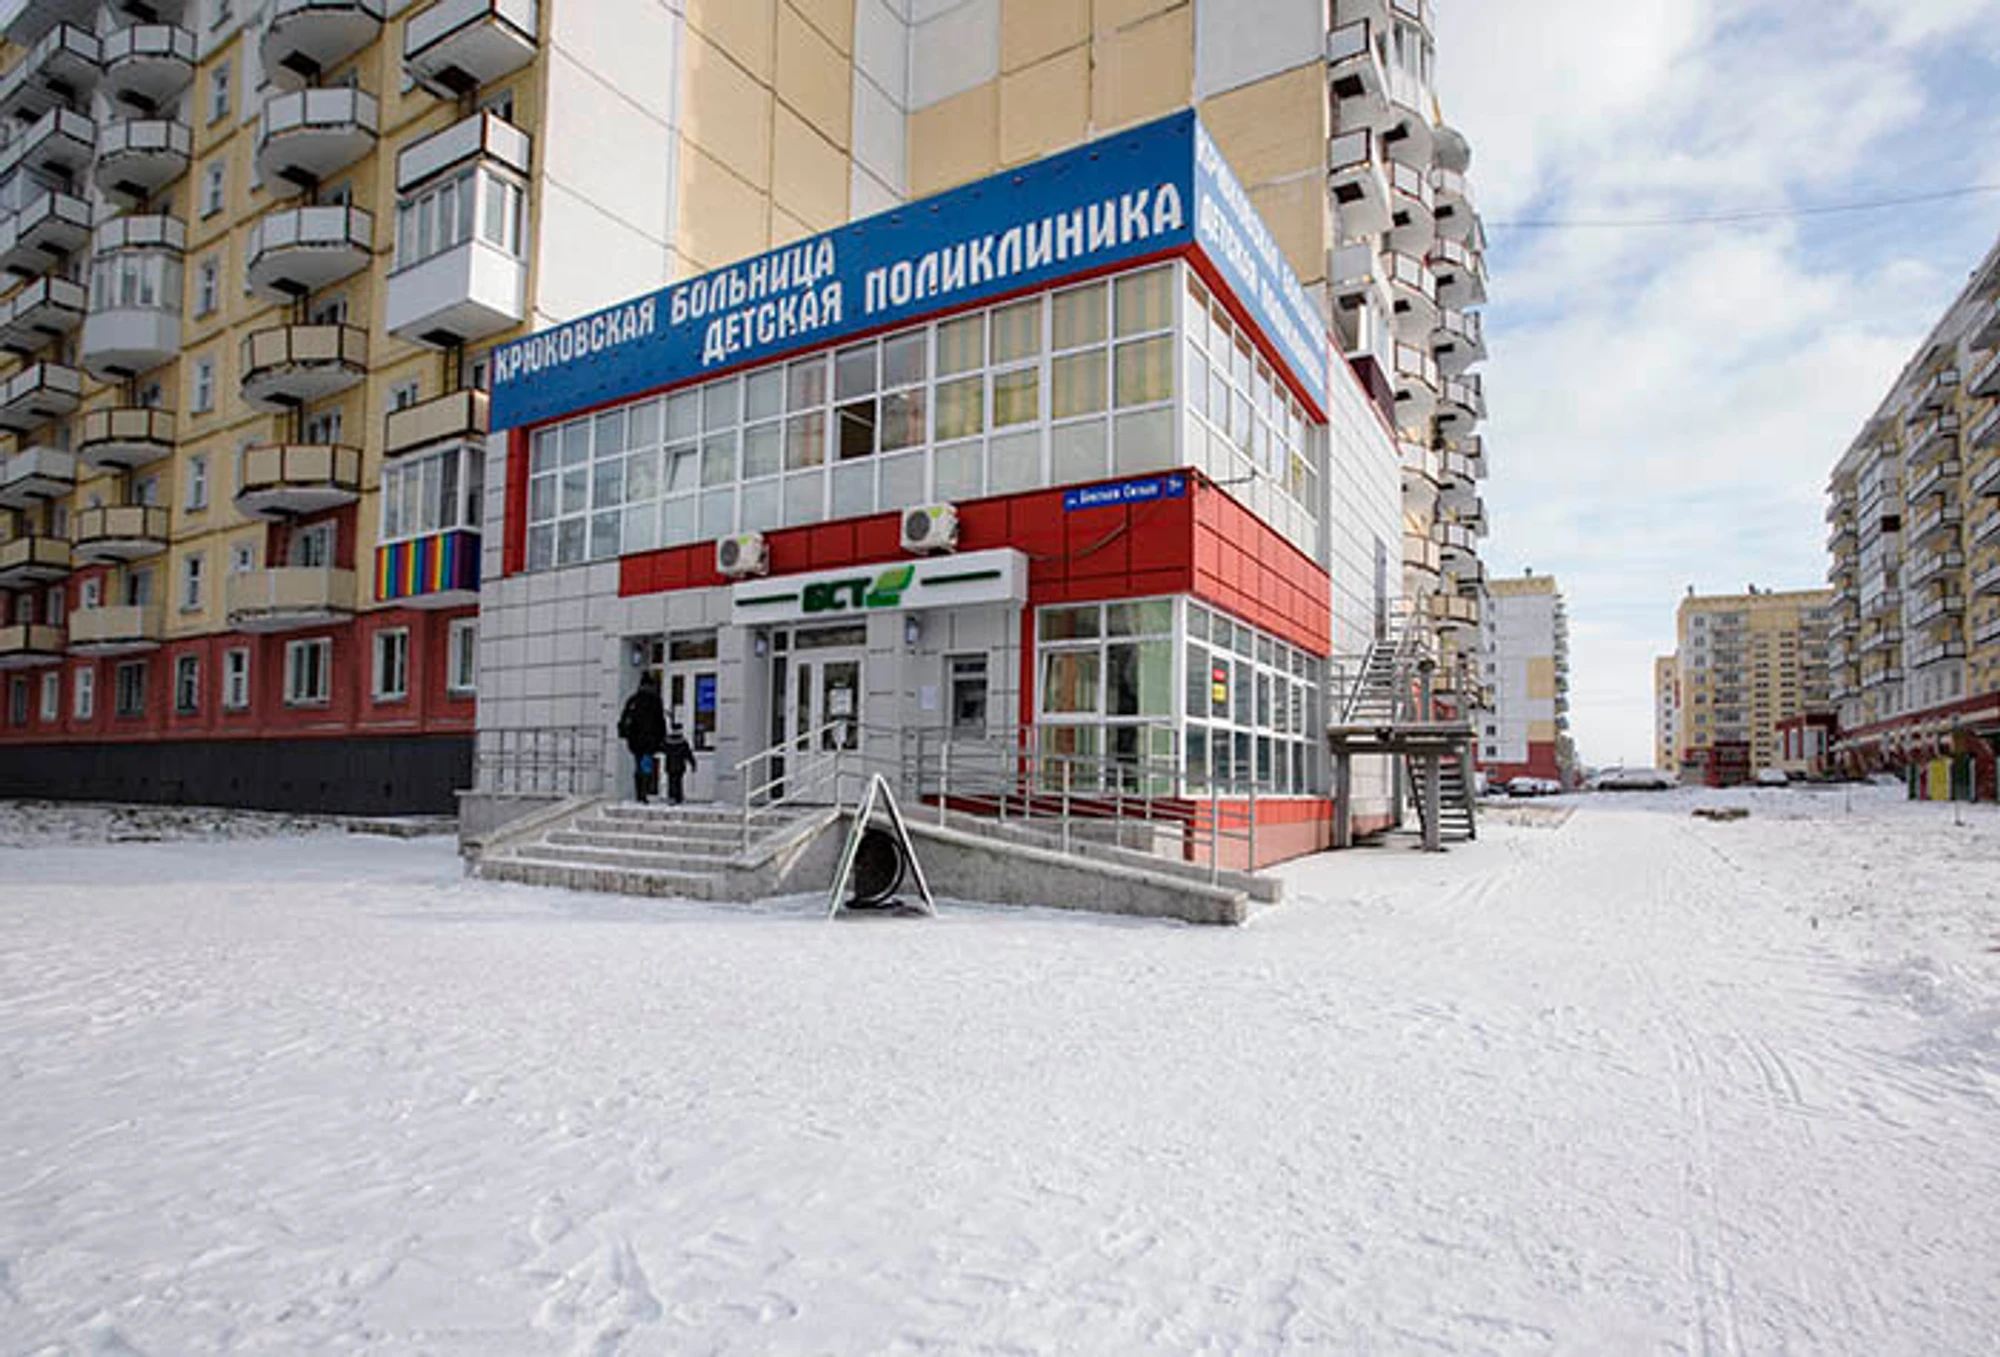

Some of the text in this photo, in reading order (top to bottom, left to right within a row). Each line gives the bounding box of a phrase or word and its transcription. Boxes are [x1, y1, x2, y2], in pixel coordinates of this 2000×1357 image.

[494, 237, 835, 383] КРЮКОВСКАЯ БОЛЬНИЦА
[703, 282, 843, 366] ДЕТСКАЯ
[865, 182, 1186, 315] ПОЛИКЛИНИКА
